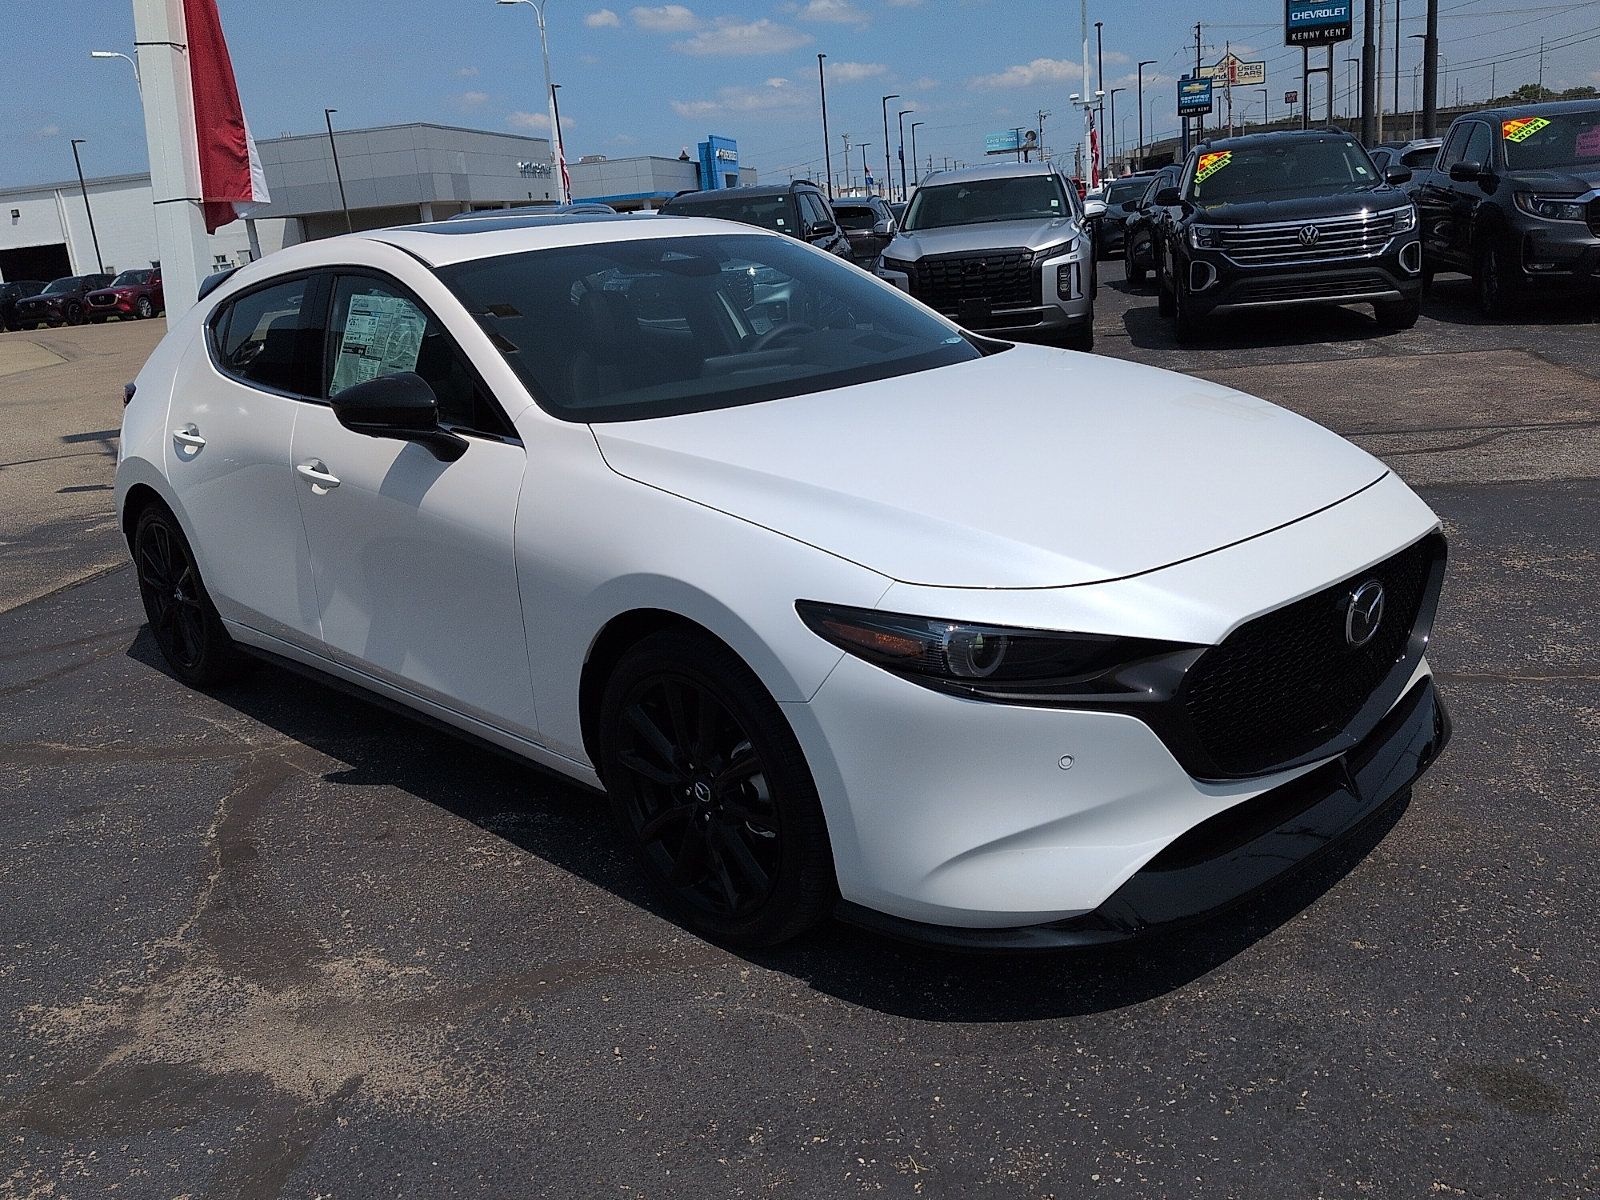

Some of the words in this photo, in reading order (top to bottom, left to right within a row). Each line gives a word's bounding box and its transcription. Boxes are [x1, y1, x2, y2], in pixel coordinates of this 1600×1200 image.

[1291, 7, 1347, 20] CHEVROLET
[1291, 31, 1320, 40] KENNY
[1324, 28, 1346, 37] KENT
